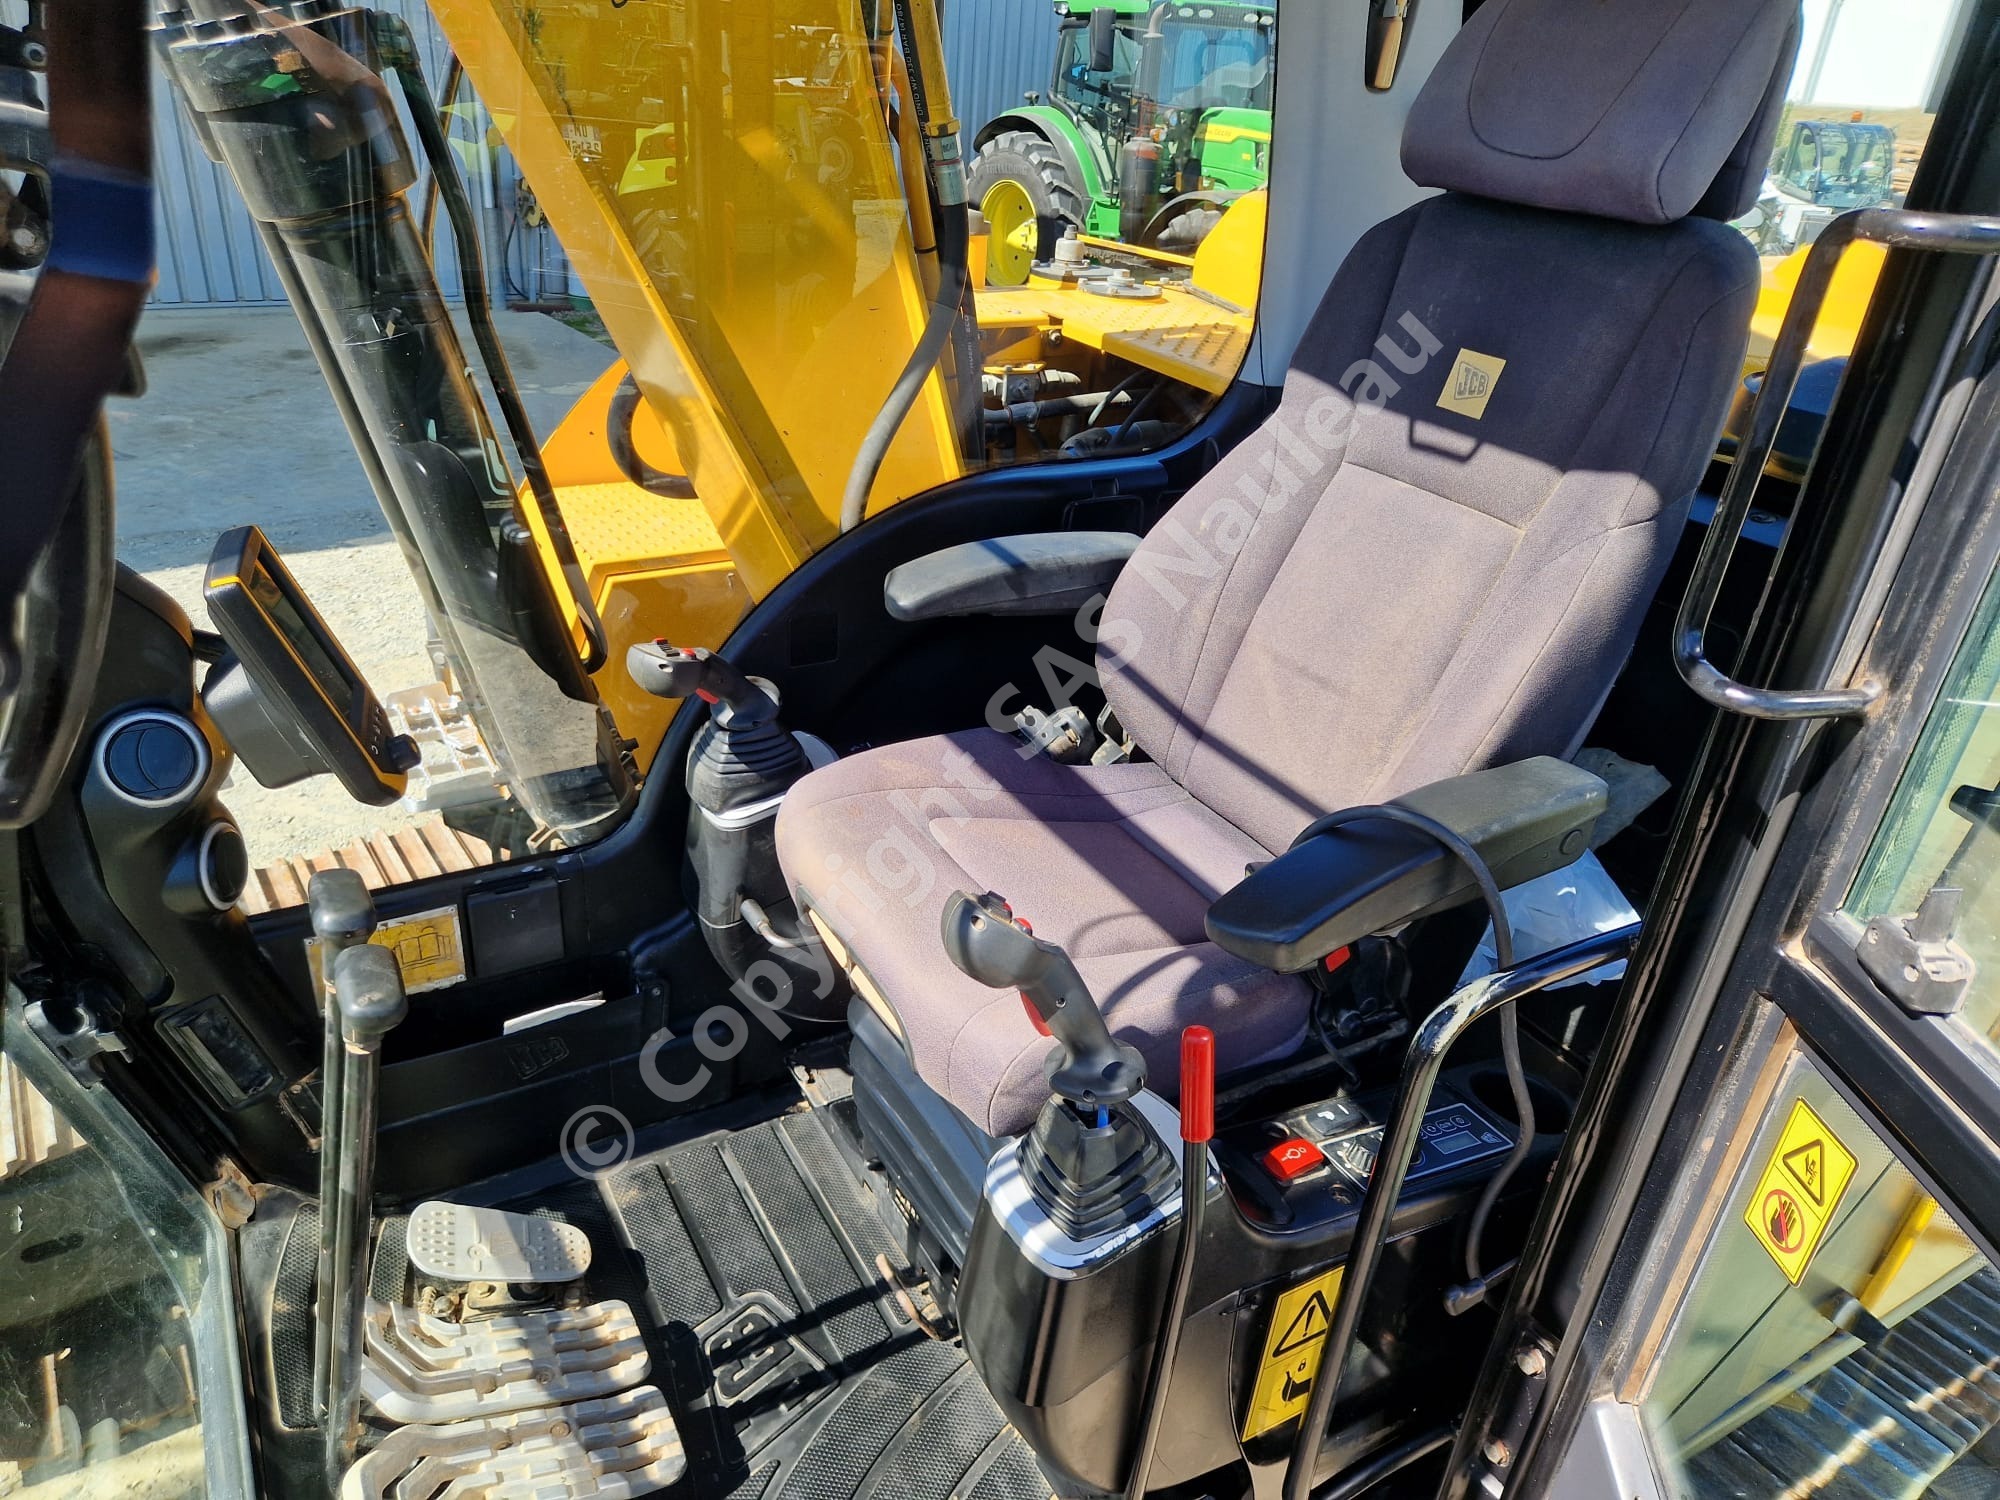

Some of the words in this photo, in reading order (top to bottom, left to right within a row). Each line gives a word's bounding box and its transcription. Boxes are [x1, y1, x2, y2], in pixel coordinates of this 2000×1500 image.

[902, 35, 912, 55] BAR
[909, 75, 919, 91] WP
[1456, 366, 1487, 397] JCB
[709, 1312, 824, 1435] JCB
